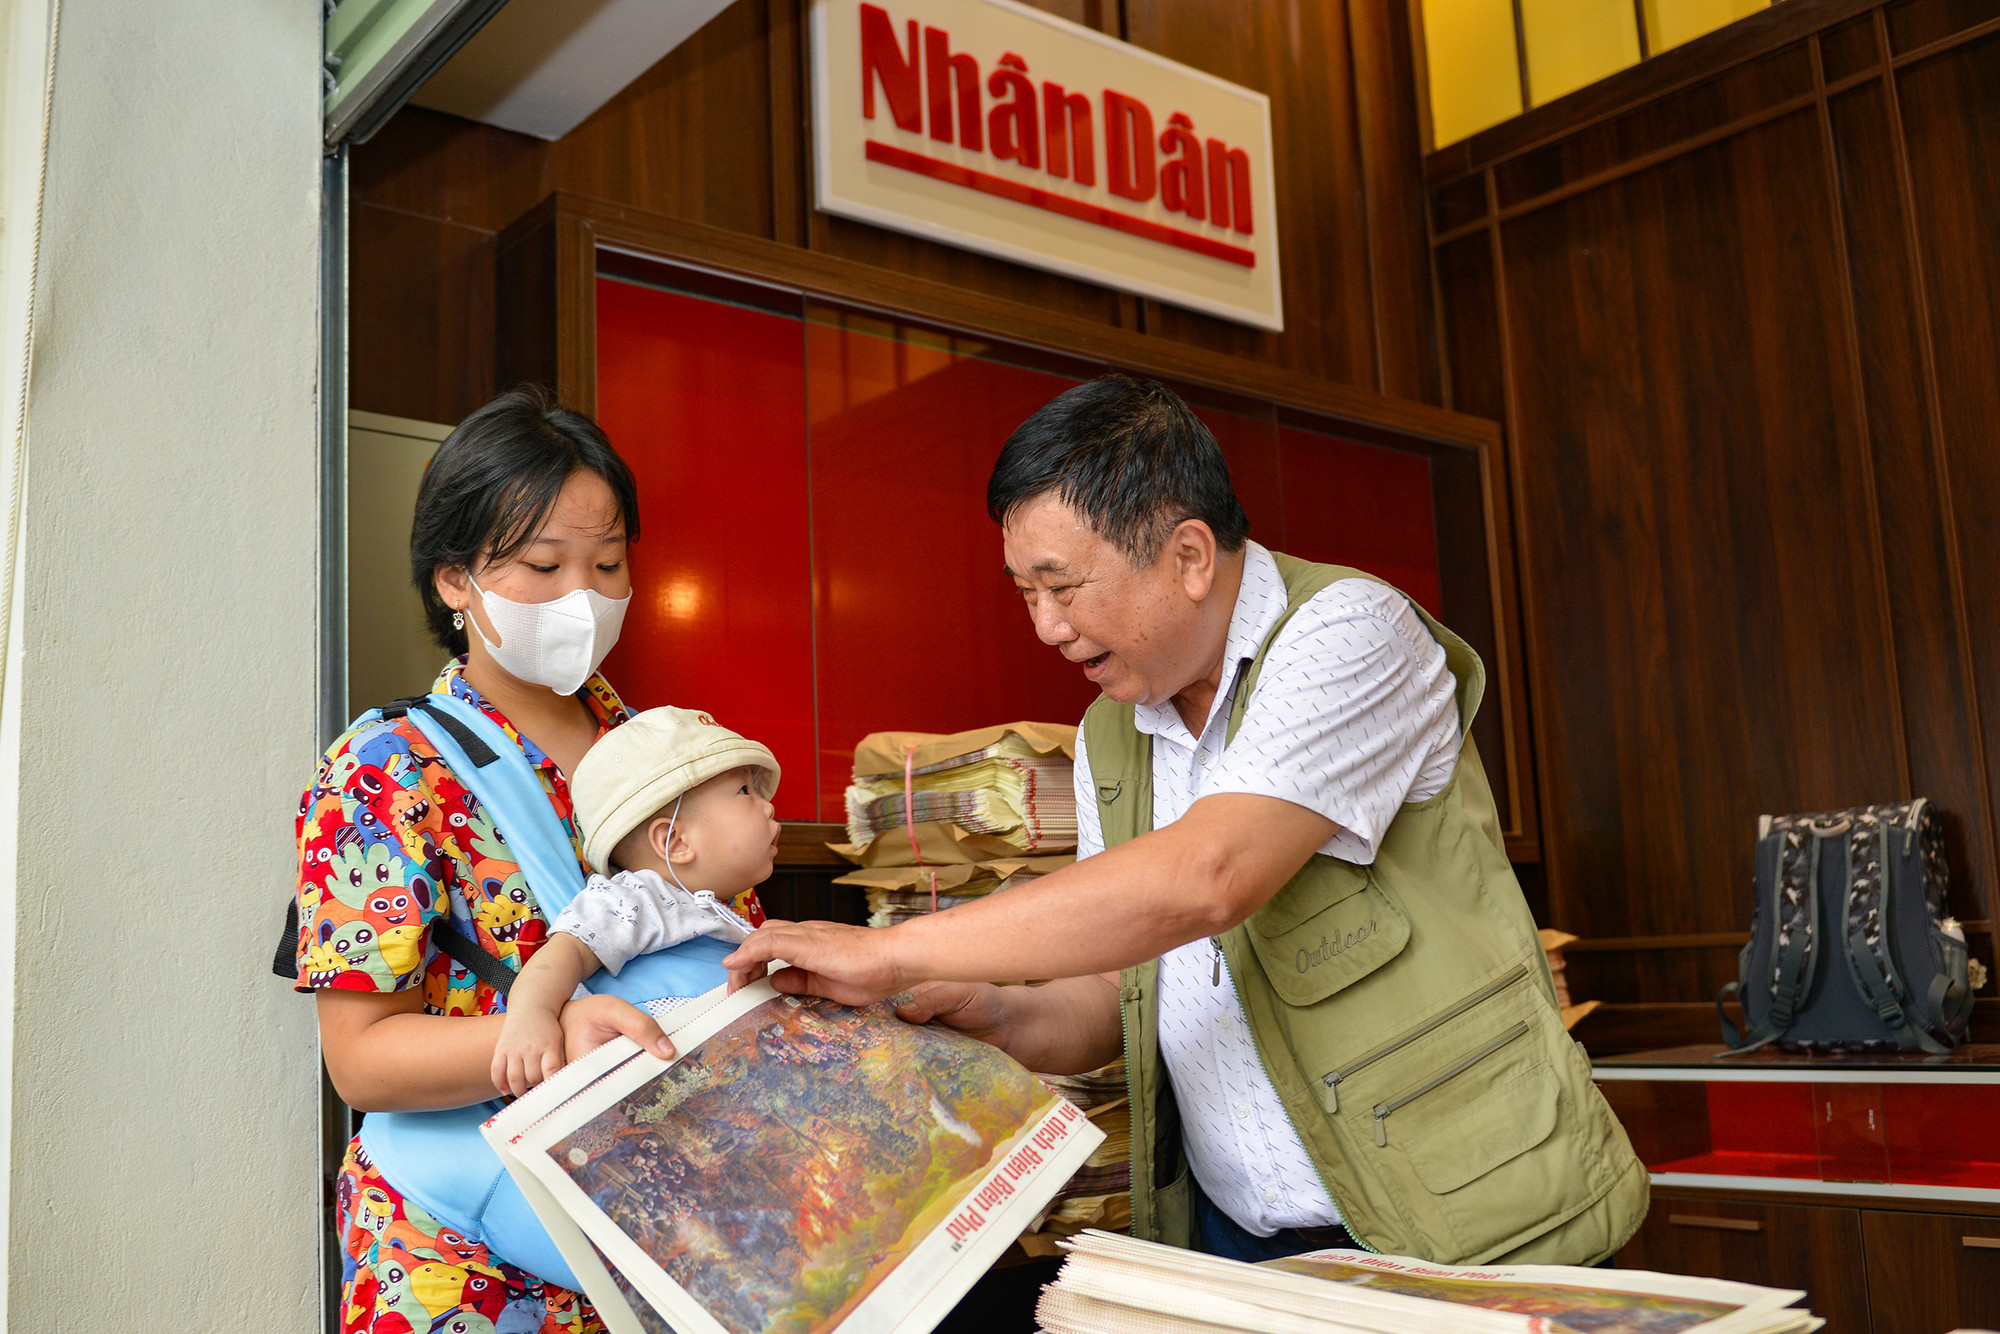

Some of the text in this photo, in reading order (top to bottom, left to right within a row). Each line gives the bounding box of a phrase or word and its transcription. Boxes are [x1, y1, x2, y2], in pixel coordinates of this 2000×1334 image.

[860, 2, 1253, 236] Nhân Dân
[1295, 919, 1380, 974] Outdoor
[1032, 1116, 1068, 1150] dịch
[1003, 1144, 1044, 1181] Điện
[974, 1174, 1016, 1211] Biên
